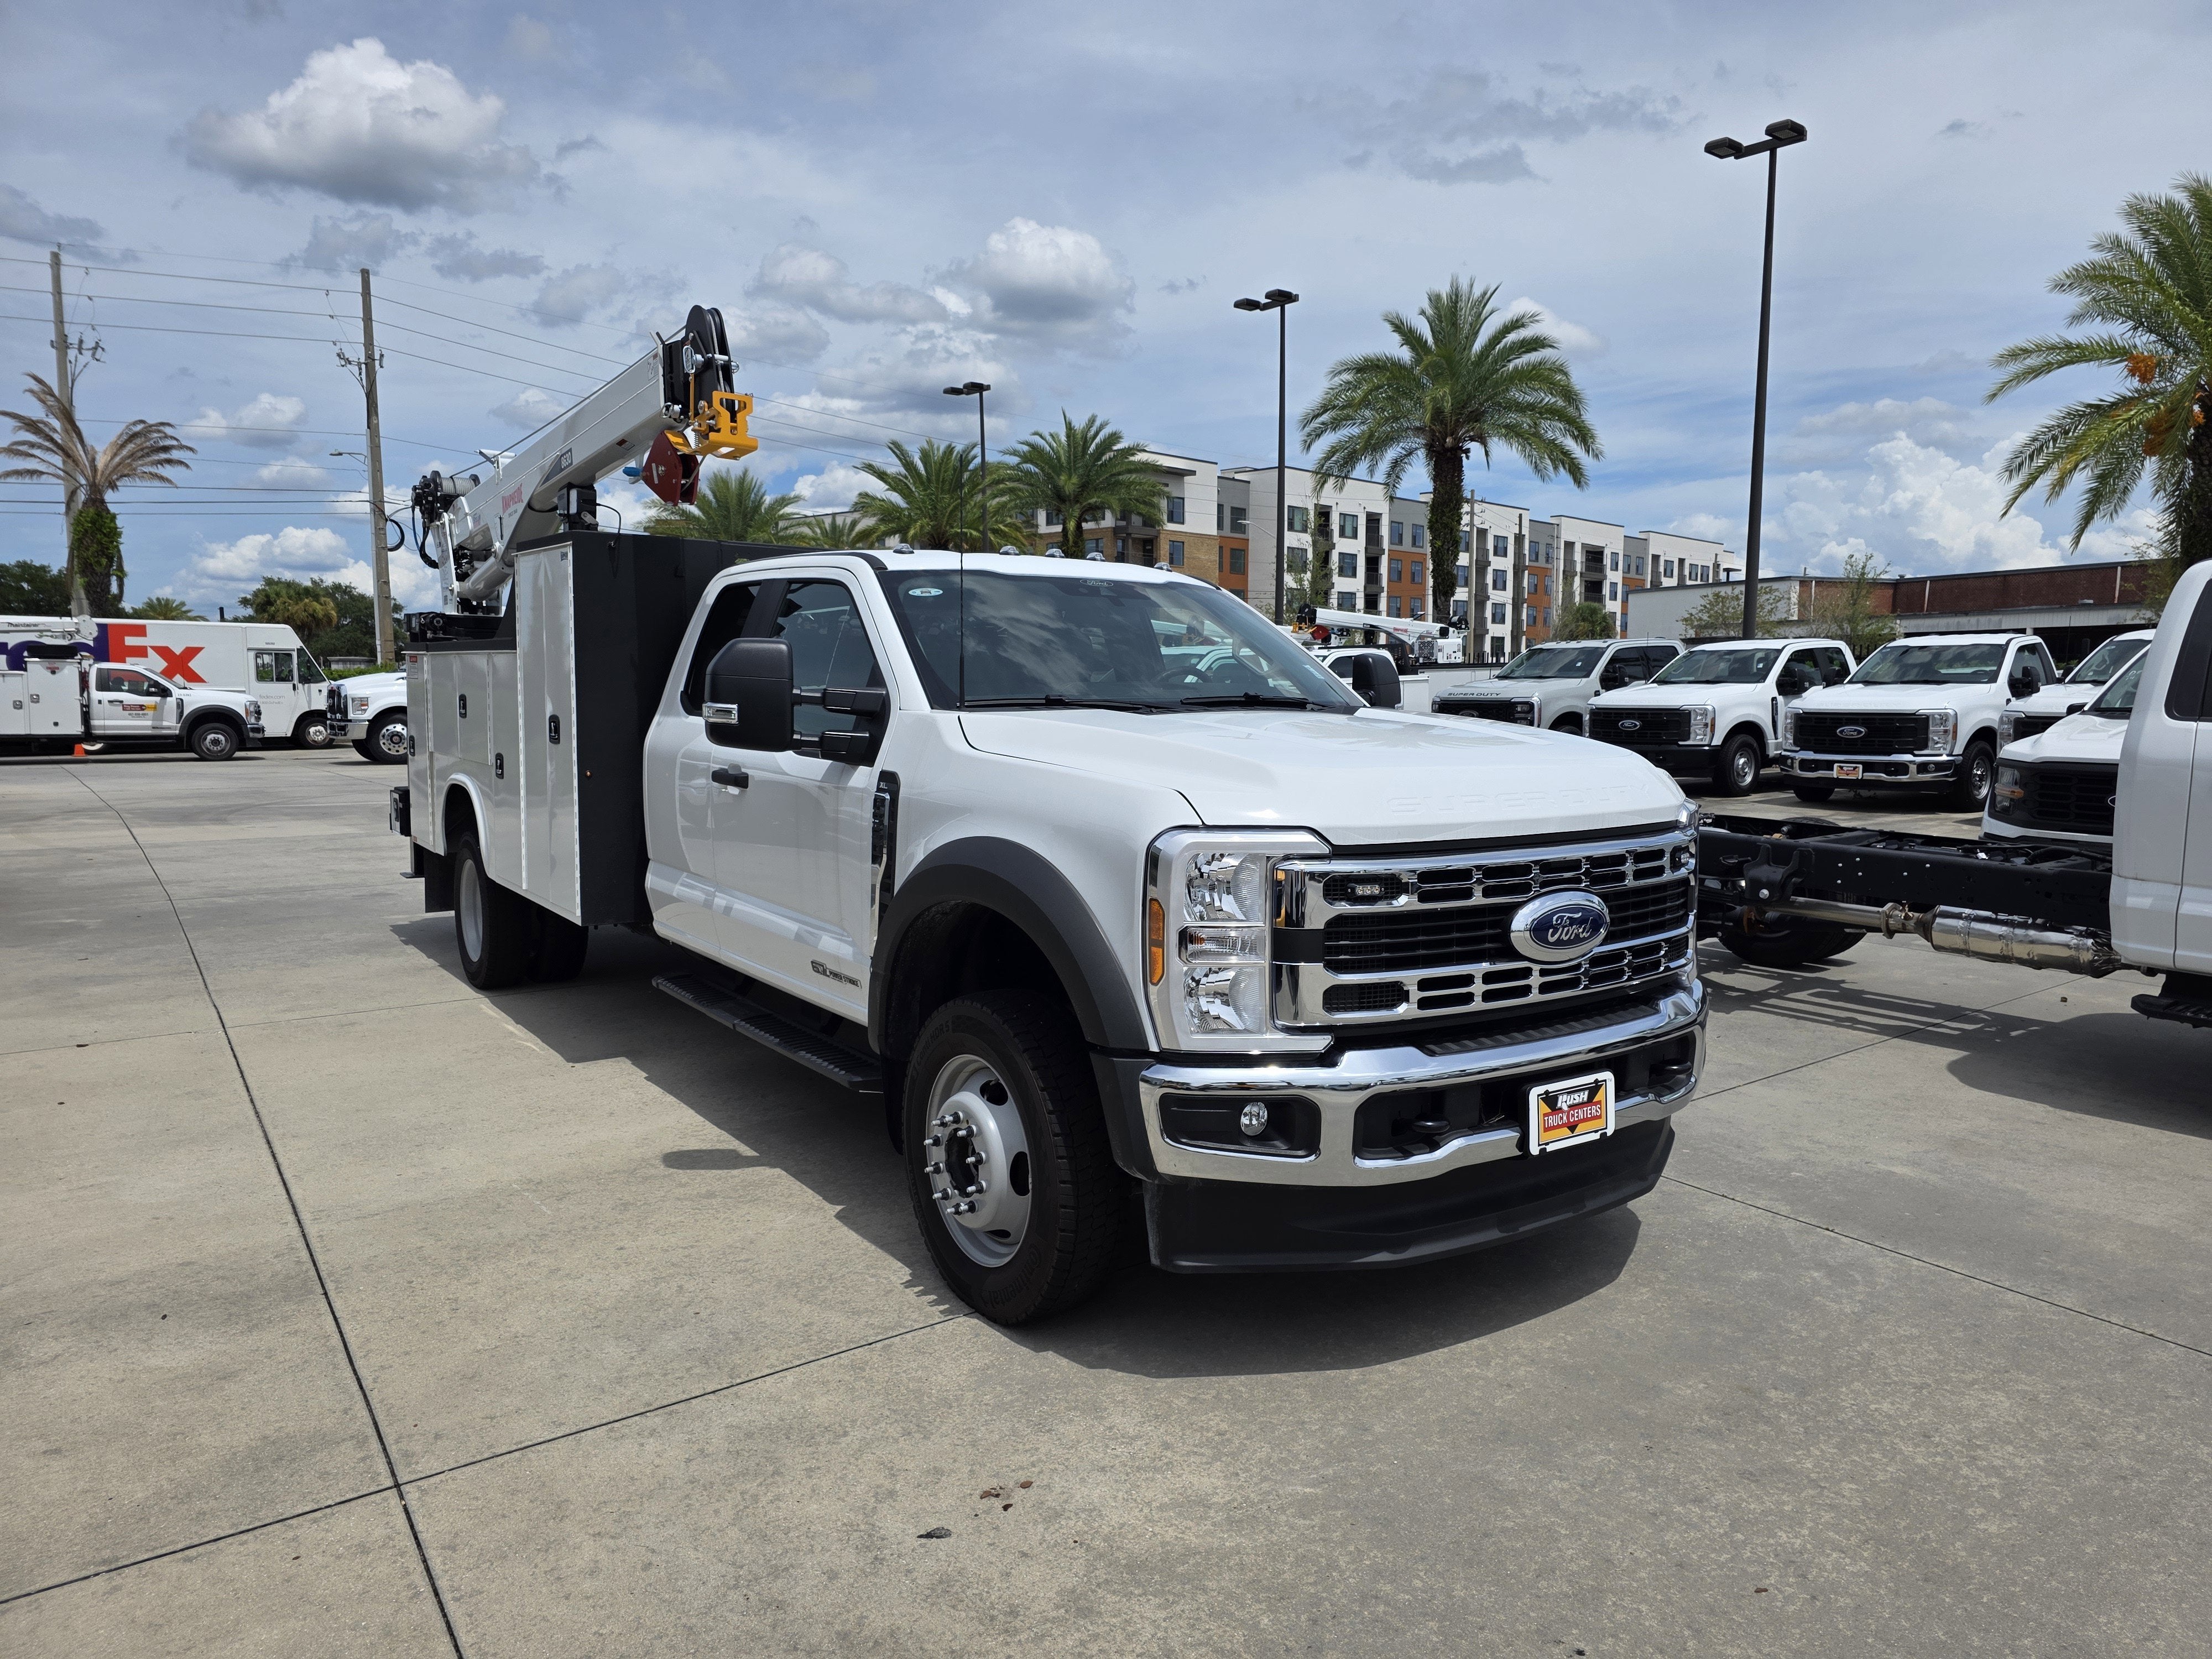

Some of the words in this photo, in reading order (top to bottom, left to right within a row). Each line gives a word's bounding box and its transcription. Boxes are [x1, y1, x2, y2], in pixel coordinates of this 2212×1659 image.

[561, 452, 571, 469] 8630
[1386, 791, 1557, 816] SUPER
[1559, 784, 1651, 807] DUTY
[1548, 912, 1593, 942] Ford
[1544, 1112, 1568, 1128] TRUCK
[1569, 1104, 1601, 1122] CENTERS
